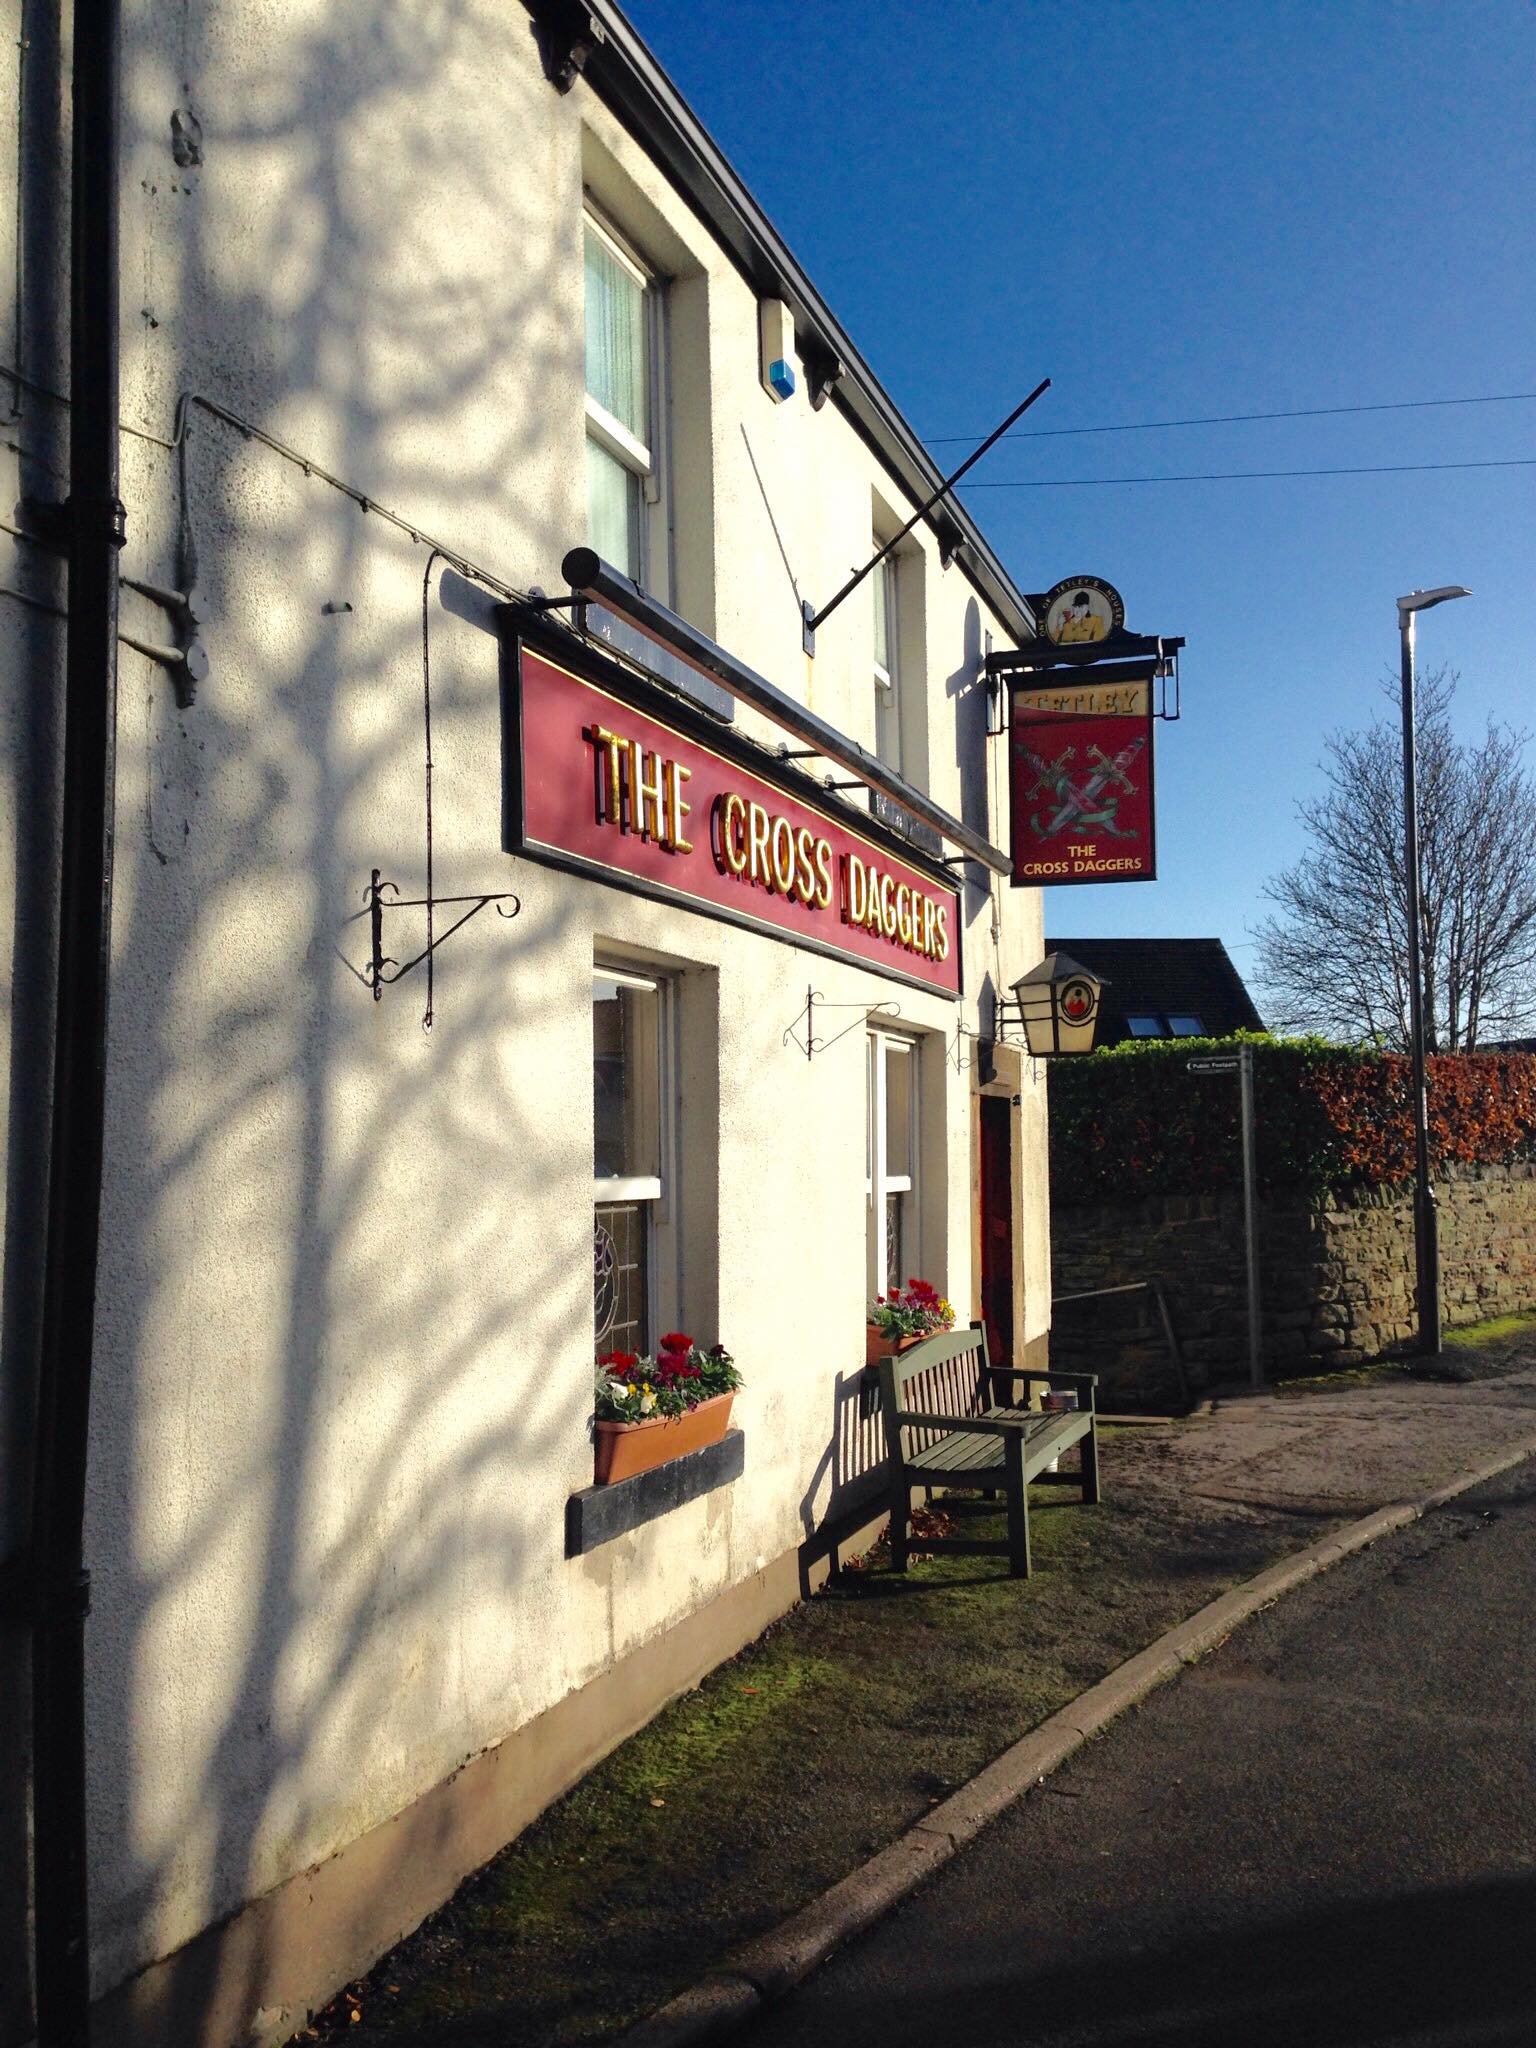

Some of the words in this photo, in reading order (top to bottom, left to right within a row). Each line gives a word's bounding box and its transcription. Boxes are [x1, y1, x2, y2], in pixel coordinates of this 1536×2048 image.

[591, 724, 694, 855] THE
[719, 791, 833, 910] CROSS
[848, 852, 949, 963] DAGGERS
[1067, 845, 1096, 857] THE
[1023, 861, 1069, 875] CROSS
[1074, 857, 1142, 873] DAGGERS
